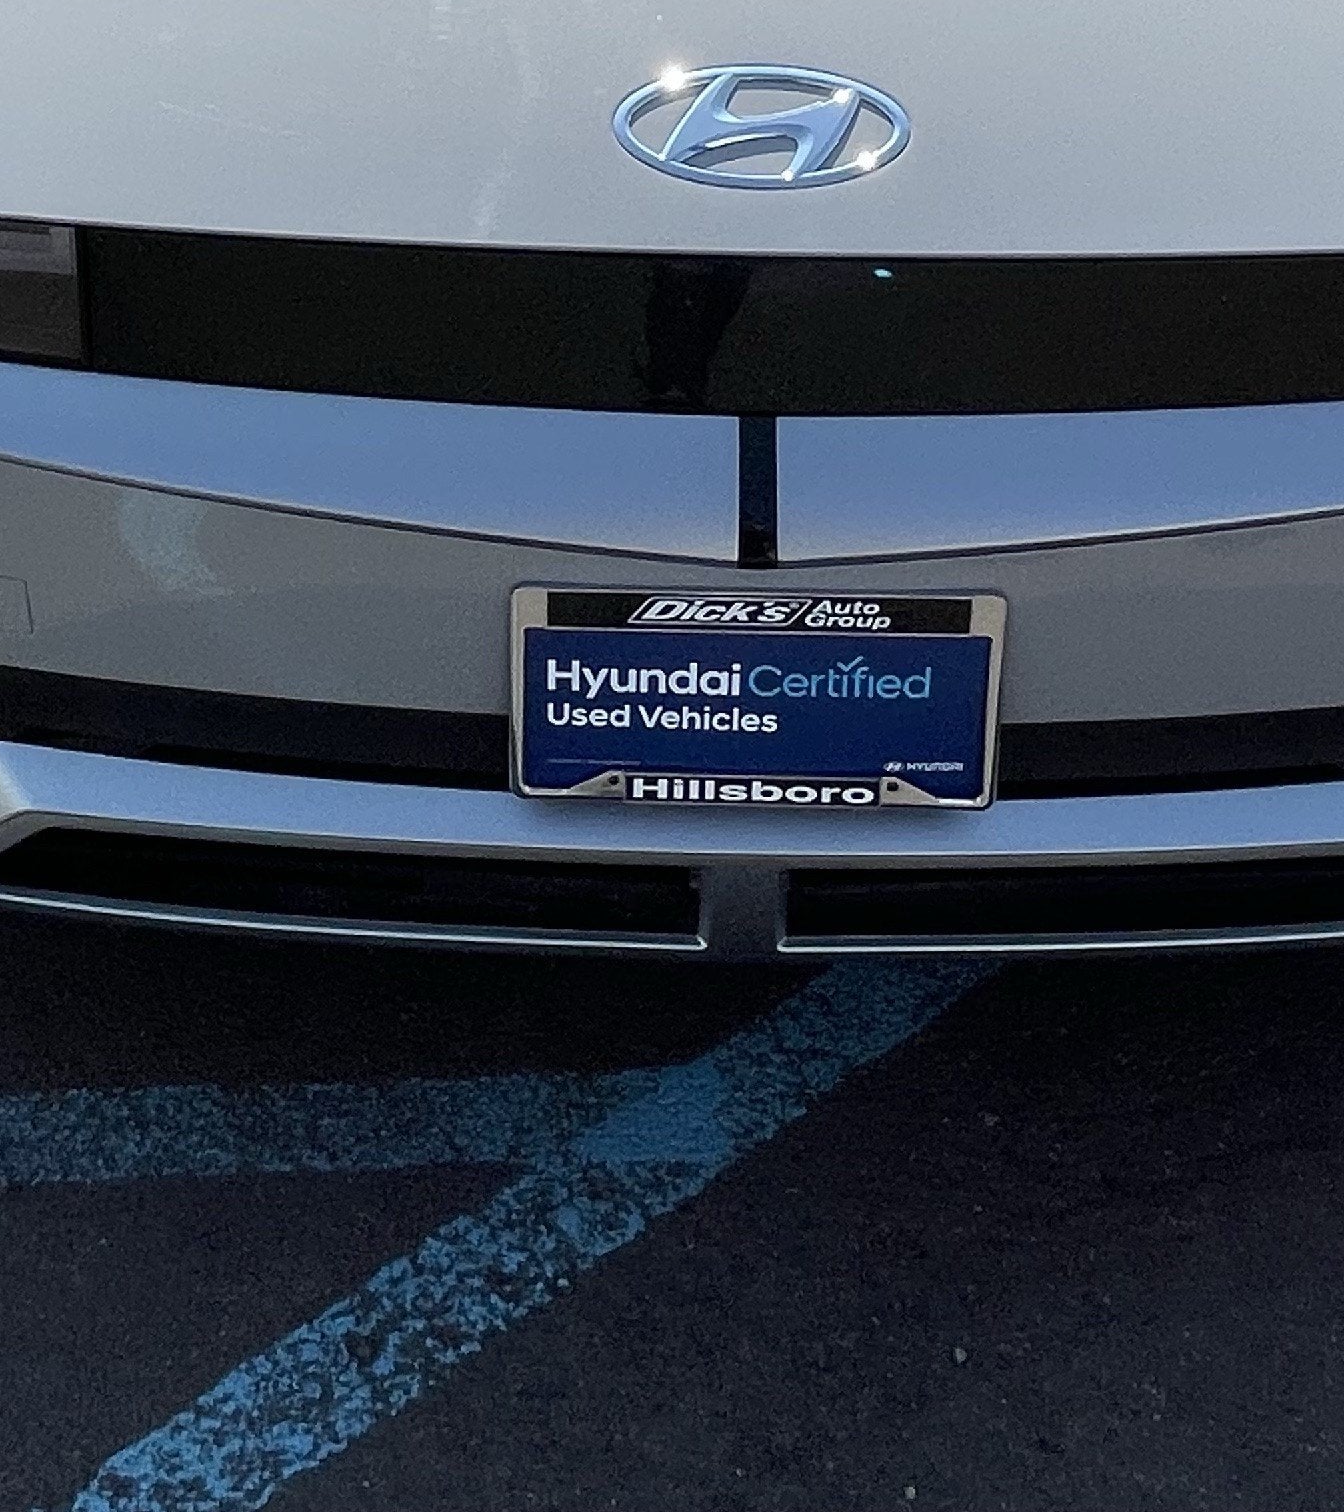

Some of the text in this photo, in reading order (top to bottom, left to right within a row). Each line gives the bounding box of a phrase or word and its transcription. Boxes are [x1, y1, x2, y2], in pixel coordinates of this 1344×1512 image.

[812, 599, 880, 615] Auto
[804, 613, 892, 630] Group
[546, 656, 932, 700] Hyundai Certified
[546, 702, 778, 733] Used Vehicles
[632, 778, 875, 804] Hillsboro
